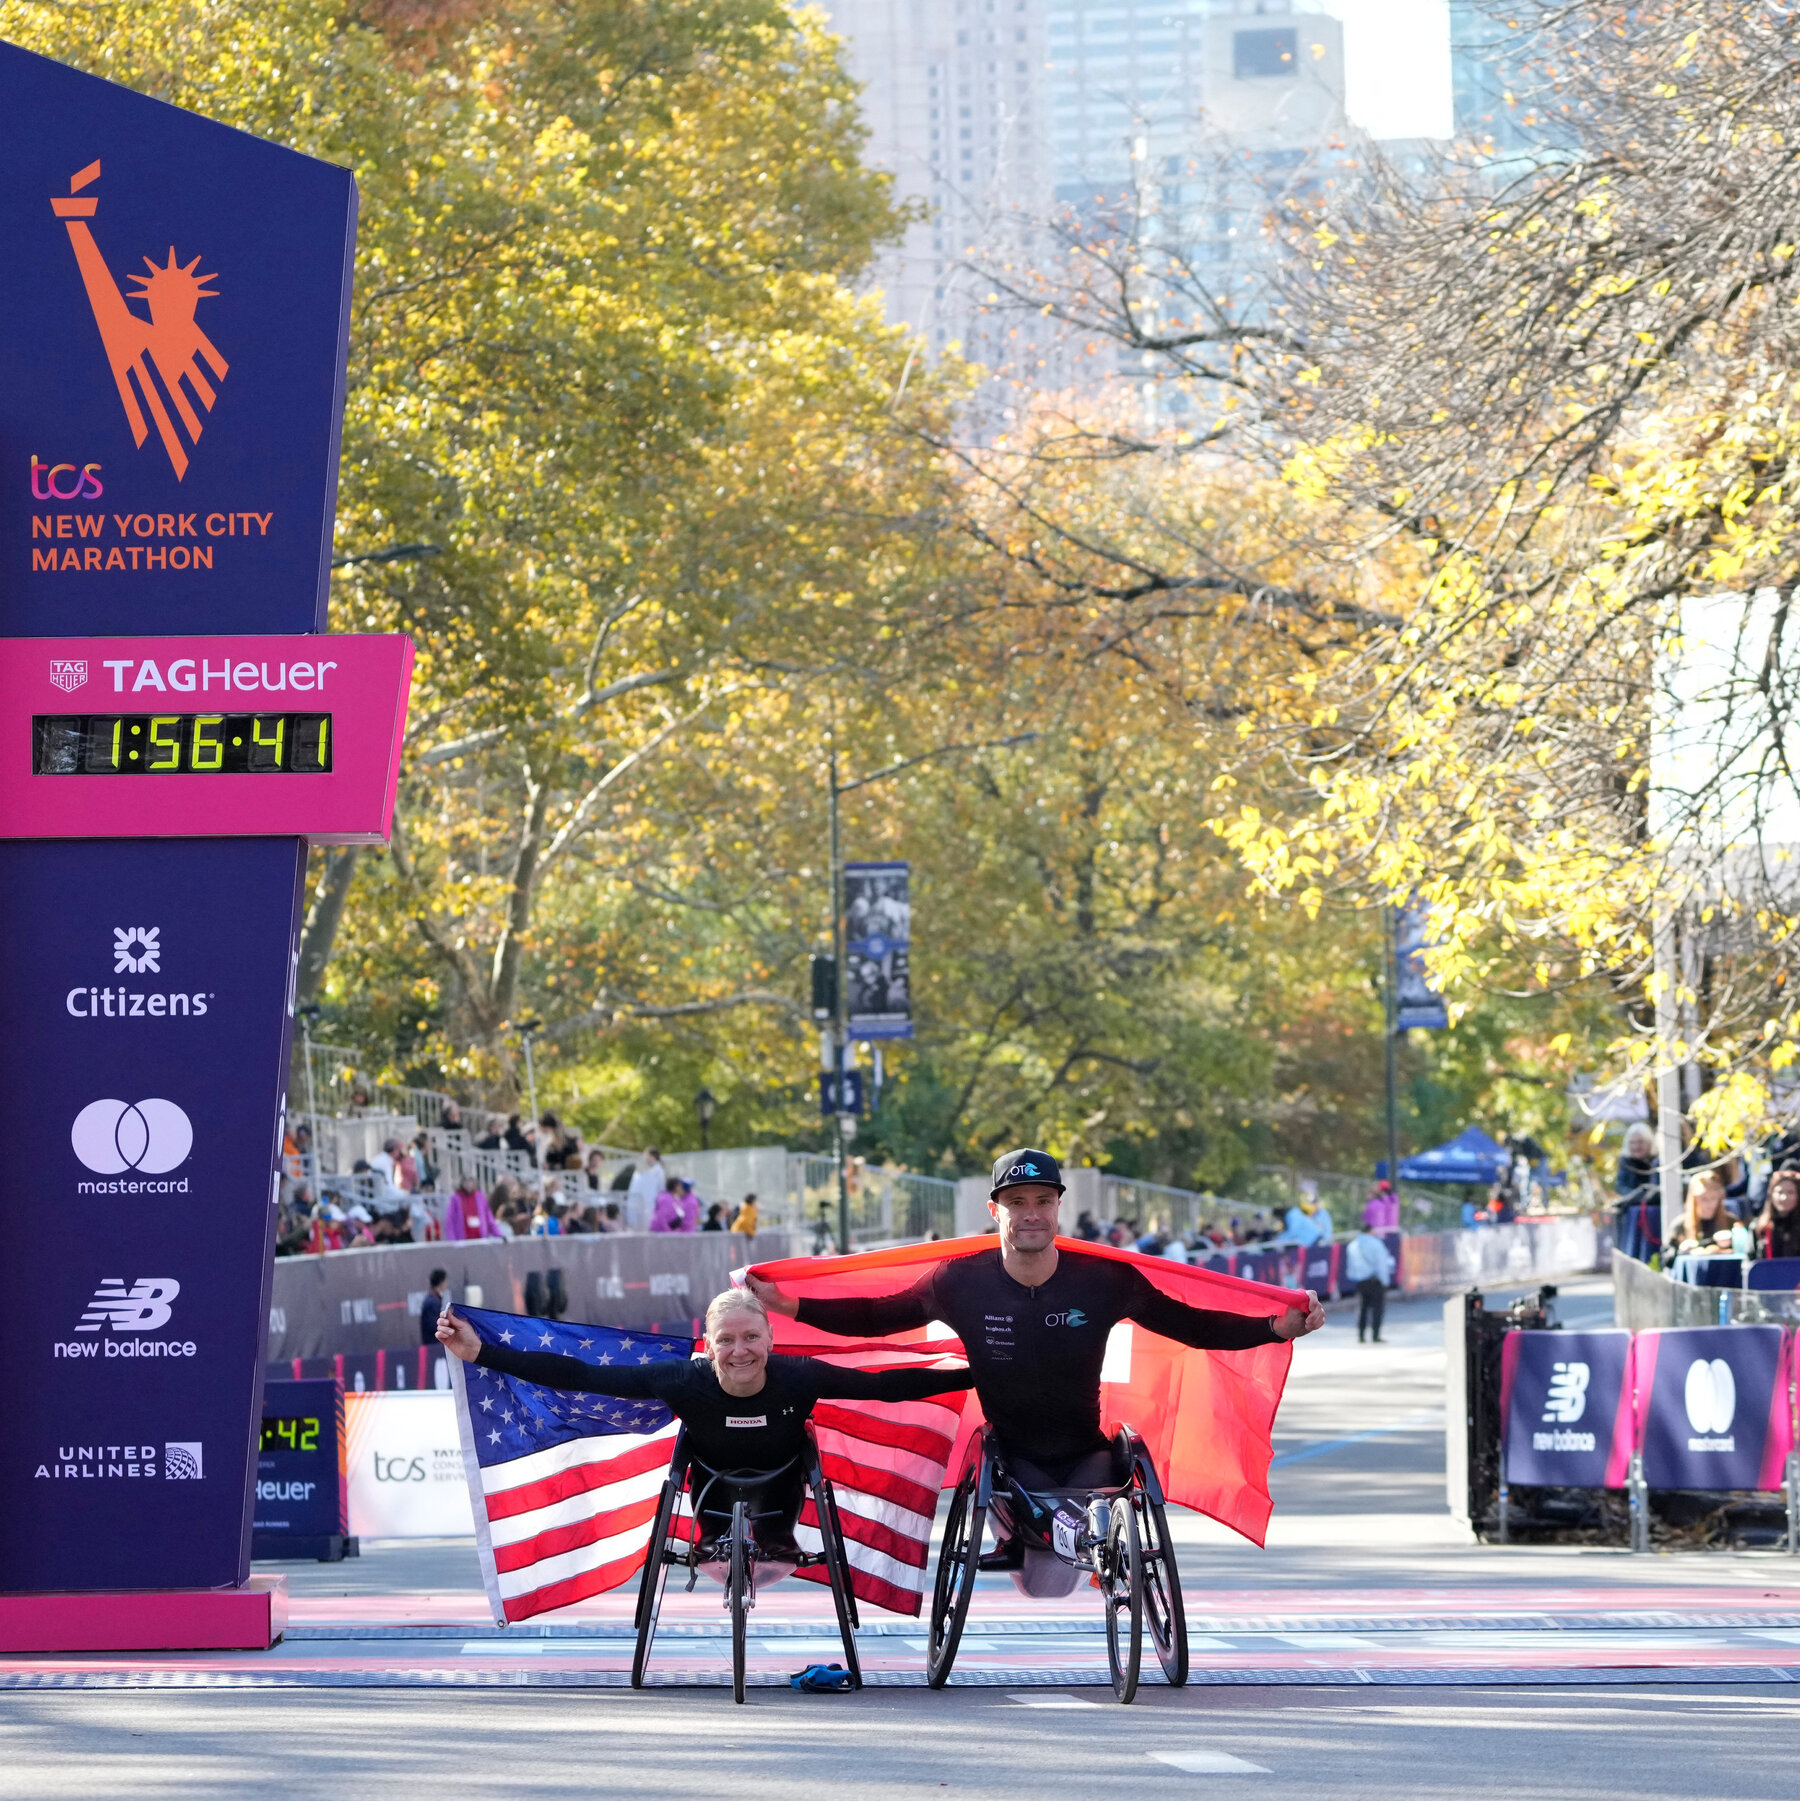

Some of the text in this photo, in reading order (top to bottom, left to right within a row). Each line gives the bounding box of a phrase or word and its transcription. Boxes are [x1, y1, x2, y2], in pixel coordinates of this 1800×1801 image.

[30, 454, 104, 500] tcs
[32, 511, 274, 539] NEW YORK CITY
[32, 545, 214, 571] MARATHON
[53, 662, 85, 673] TAG
[52, 674, 86, 690] HEUER
[66, 986, 209, 1018] Citizens
[77, 1177, 189, 1195] mastercard
[984, 1314, 1005, 1322] Allianz
[54, 1337, 197, 1358] new balance
[59, 1445, 157, 1461] UNITED
[34, 1463, 157, 1479] AIRLINES
[374, 1450, 426, 1482] tcs
